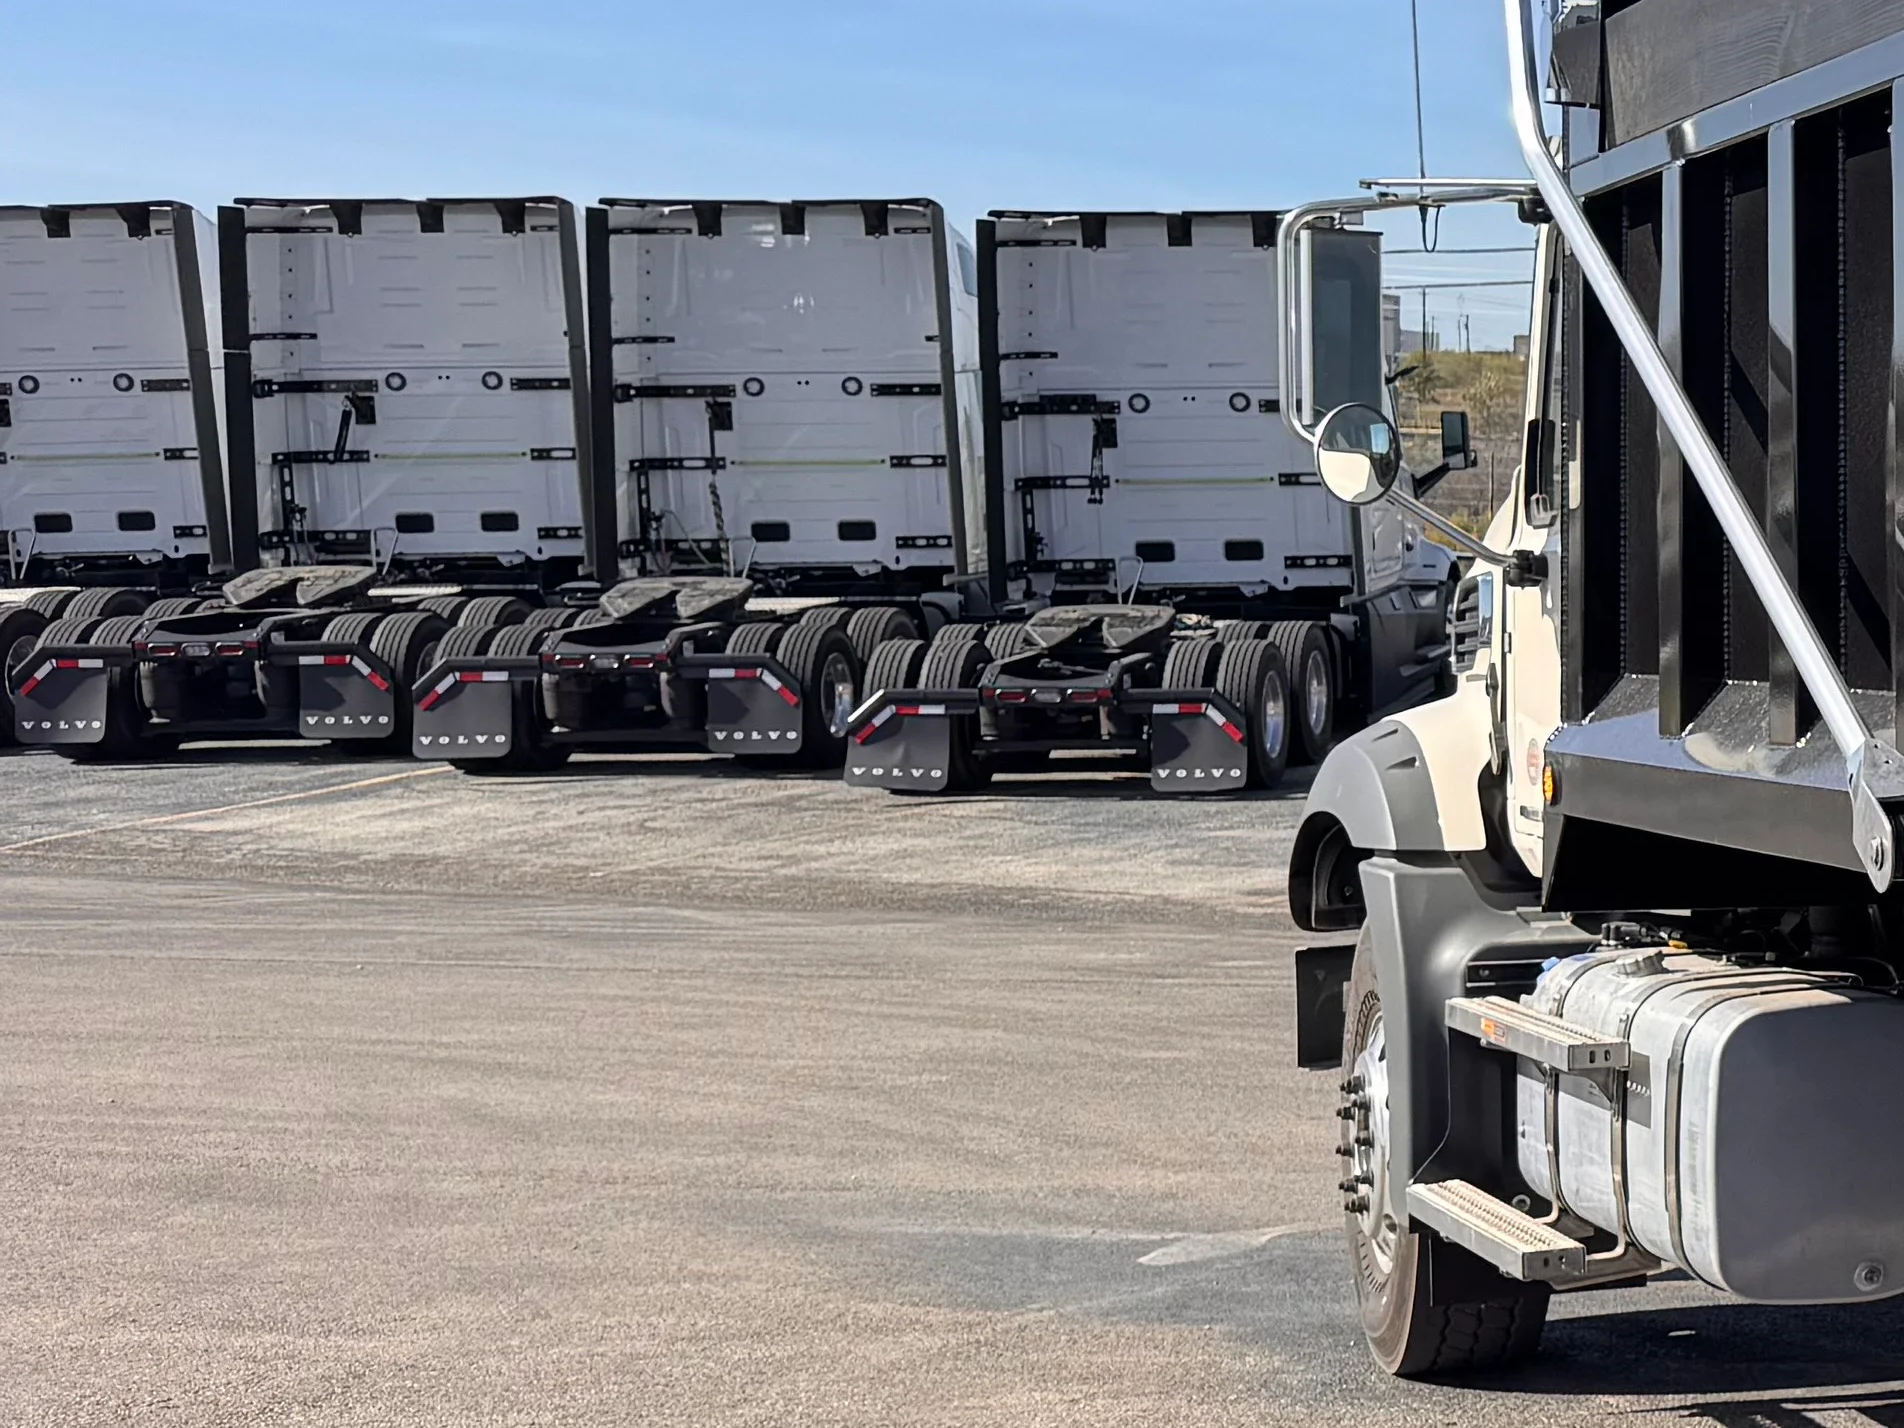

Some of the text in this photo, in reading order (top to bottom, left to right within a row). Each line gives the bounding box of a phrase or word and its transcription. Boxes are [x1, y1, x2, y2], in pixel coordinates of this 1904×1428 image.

[21, 721, 102, 730] VOLVO
[305, 715, 390, 726] VOLVO
[418, 733, 507, 745] VOLVO
[713, 730, 799, 741] VOLVO
[851, 766, 943, 779] VOLVO
[1156, 767, 1242, 779] VOLVO
